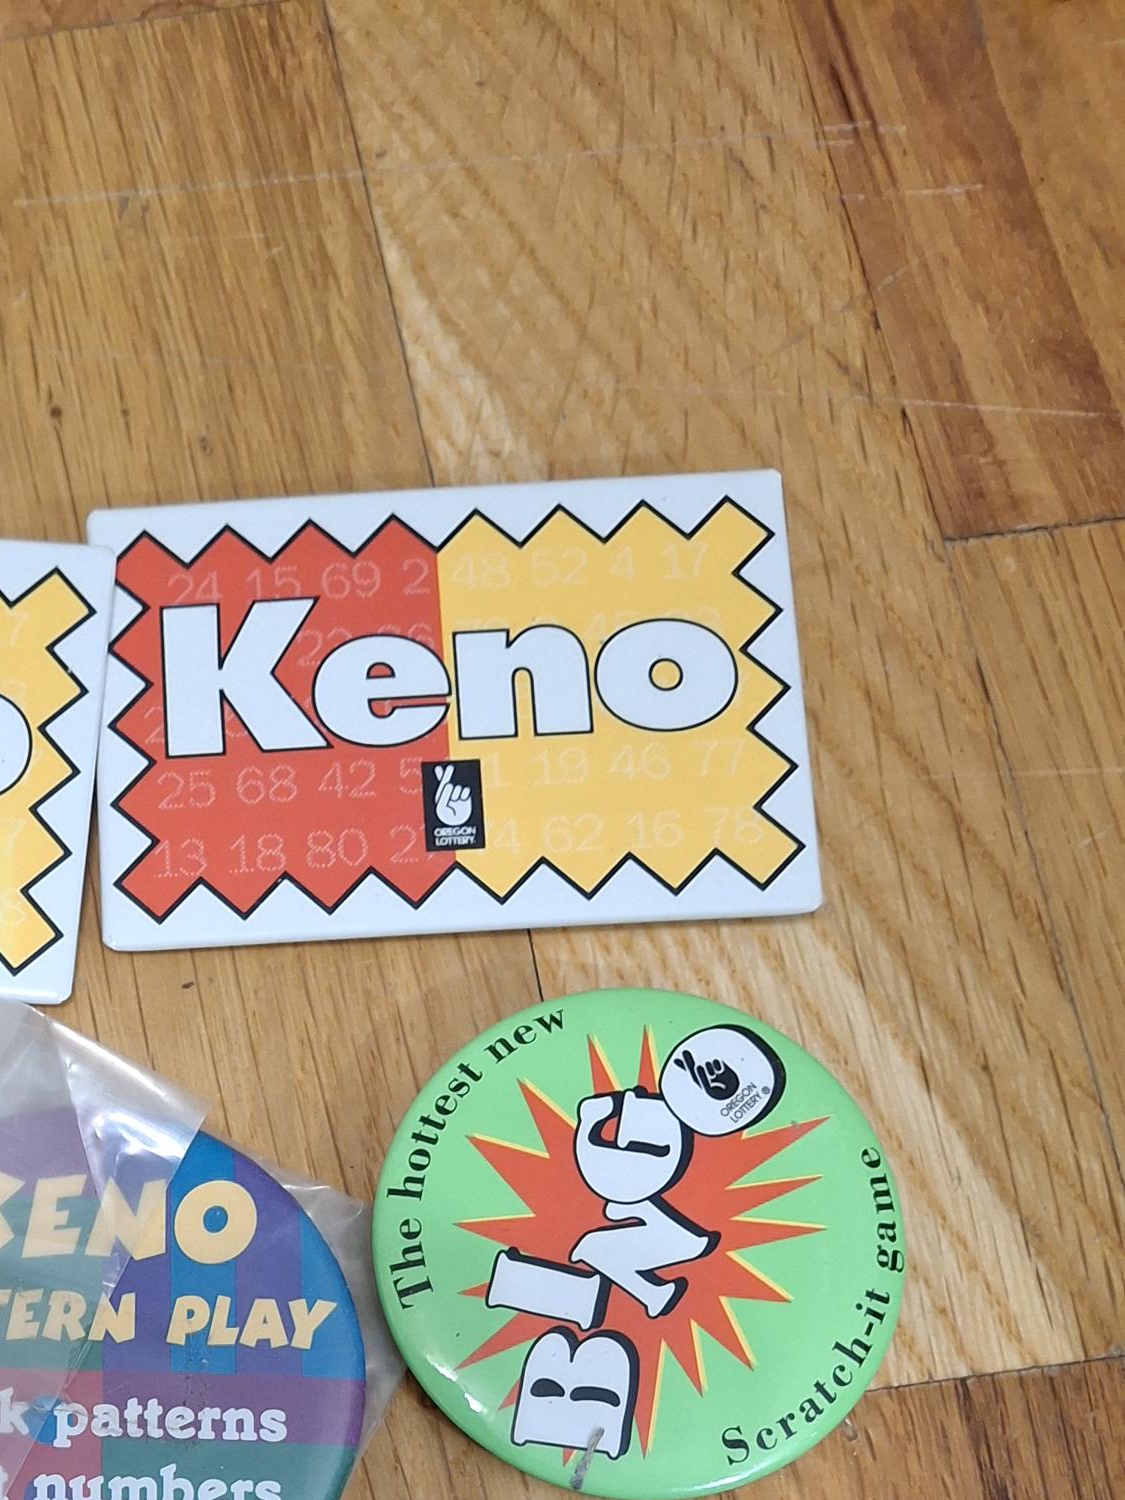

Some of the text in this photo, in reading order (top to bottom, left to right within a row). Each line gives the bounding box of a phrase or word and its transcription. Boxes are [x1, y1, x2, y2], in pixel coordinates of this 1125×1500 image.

[245, 564, 302, 599] 15
[320, 559, 382, 600] 69
[402, 556, 430, 595] 2
[451, 553, 511, 591] 48
[530, 548, 588, 586] 52
[608, 543, 636, 582] 4
[660, 540, 710, 583] 17
[159, 597, 739, 758] Keno
[154, 768, 217, 811] 25
[235, 763, 299, 806] 68
[316, 759, 377, 800] 42
[531, 747, 589, 788] 19
[608, 741, 672, 782] 46
[689, 737, 748, 778] 77
[152, 836, 208, 879] 13
[227, 830, 287, 875] 18
[306, 825, 368, 869] 80
[542, 812, 604, 853] 62
[627, 808, 683, 849] 16
[434, 826, 477, 838] OREGON
[720, 1081, 758, 1117] OREGON
[387, 1007, 567, 1311] The hottest new
[165, 1294, 339, 1350] PLAY
[721, 1145, 906, 1469] Scratch-it game
[52, 1396, 289, 1449] patterns
